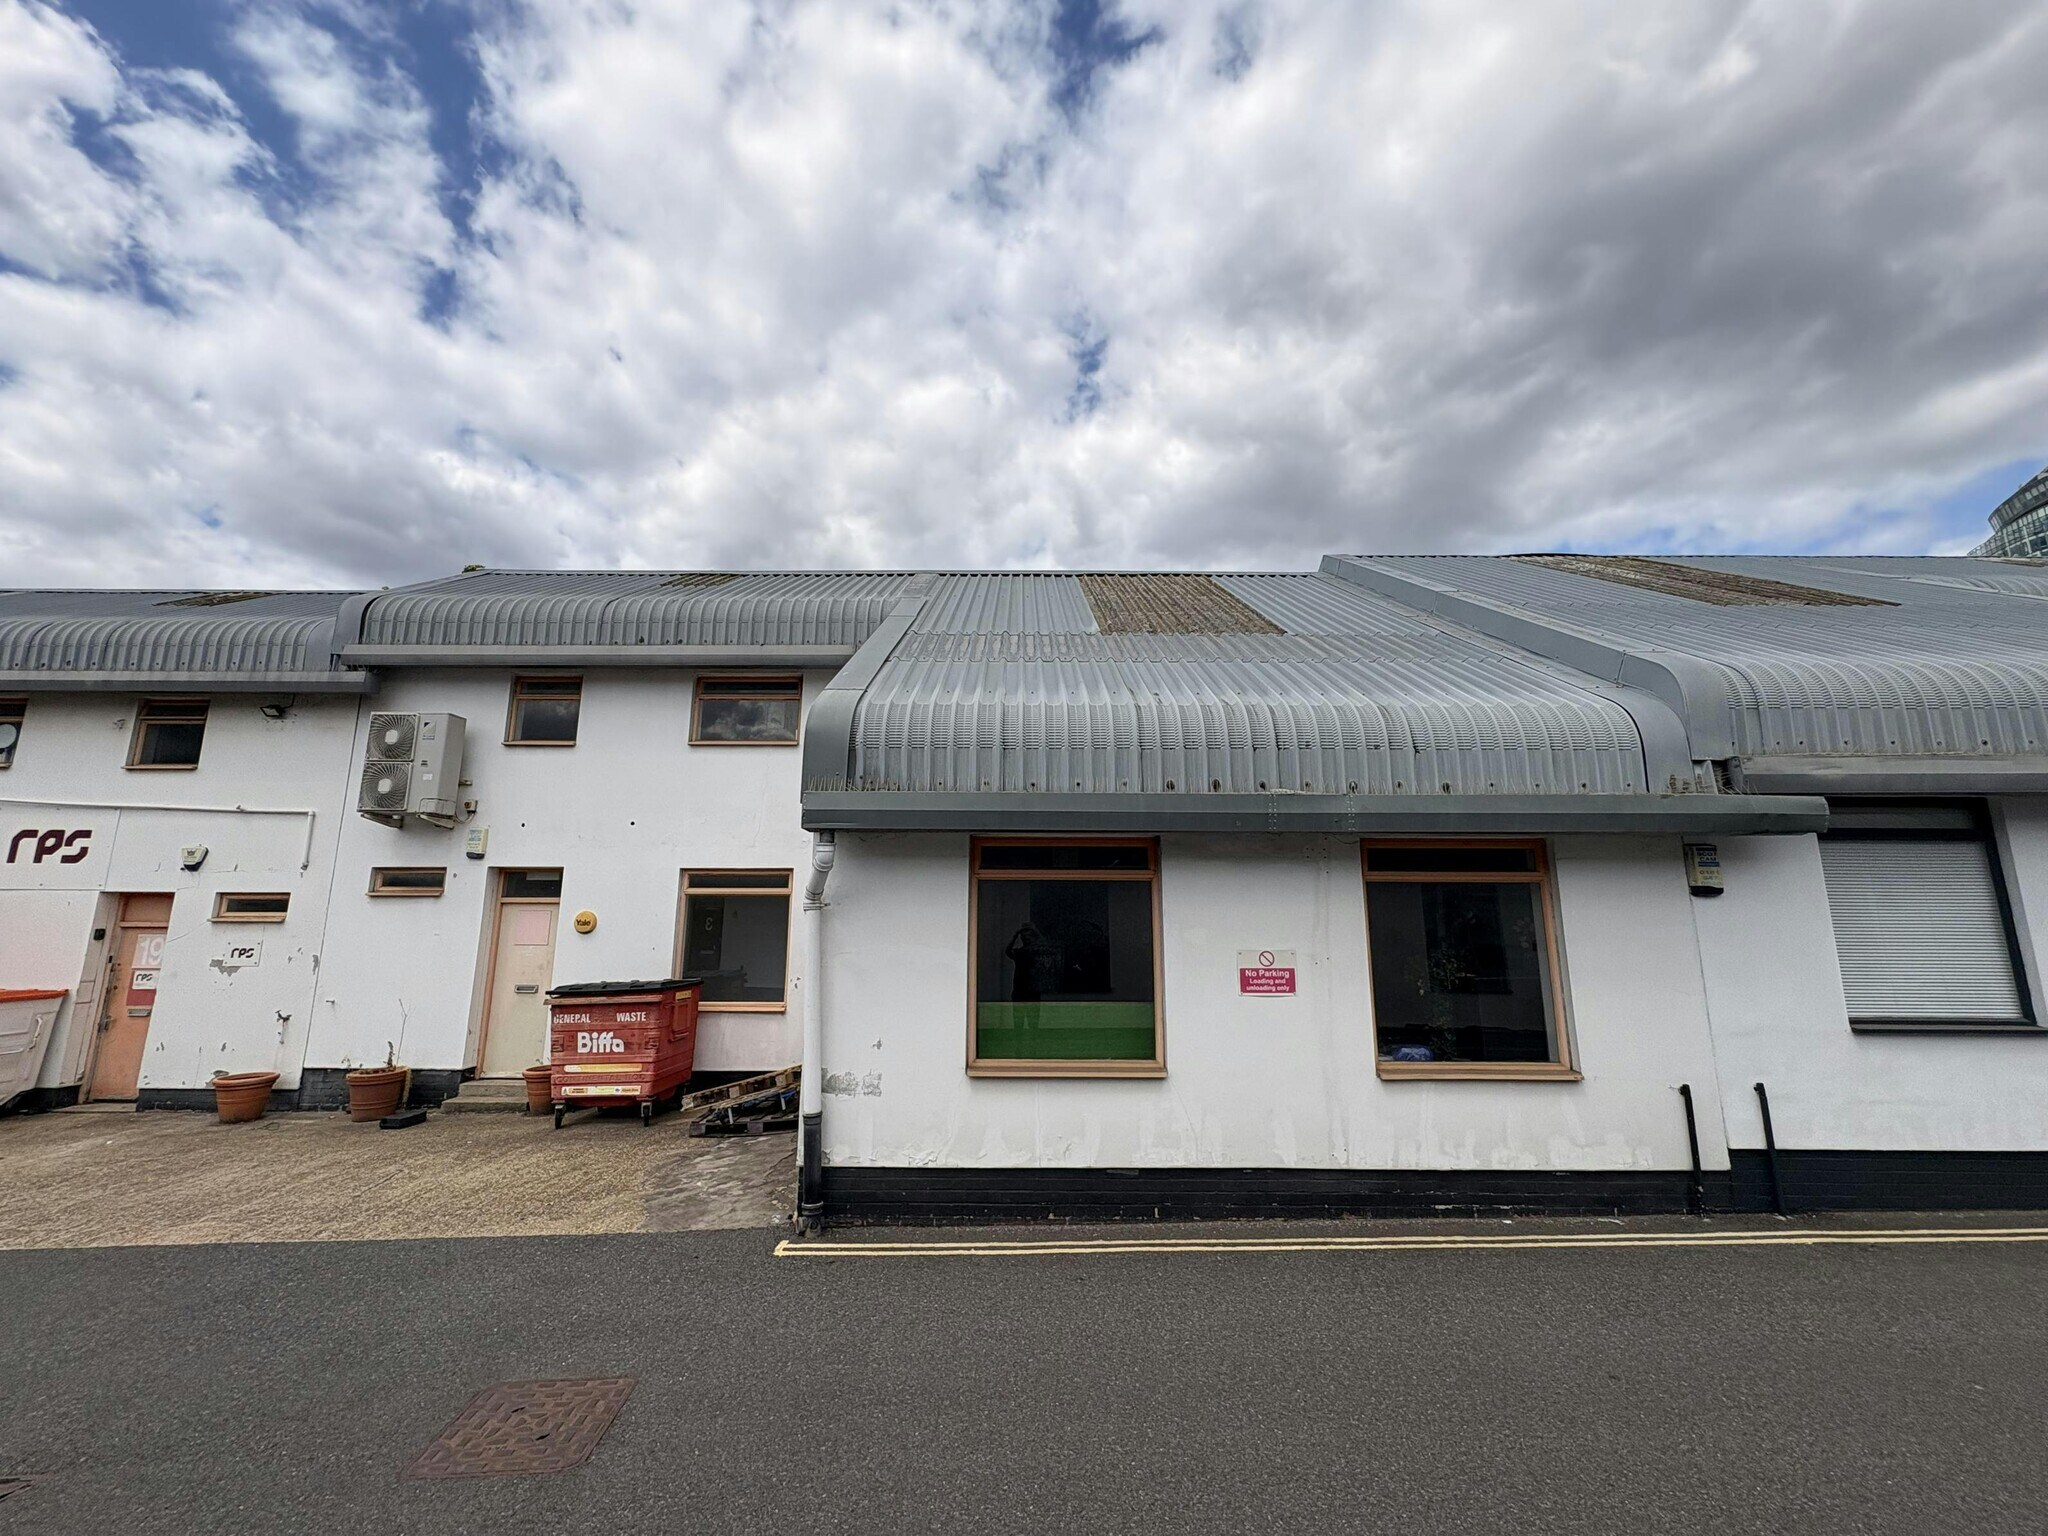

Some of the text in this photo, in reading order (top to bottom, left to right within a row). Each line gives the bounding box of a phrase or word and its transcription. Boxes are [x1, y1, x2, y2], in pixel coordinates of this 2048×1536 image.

[6, 829, 93, 864] rps
[576, 919, 591, 927] Yale
[138, 936, 163, 966] 19
[230, 947, 255, 958] rps
[136, 973, 153, 982] rps
[1259, 970, 1290, 978] Parking
[553, 1012, 646, 1023] GENERAL WASTE
[577, 1031, 624, 1053] Biffa
